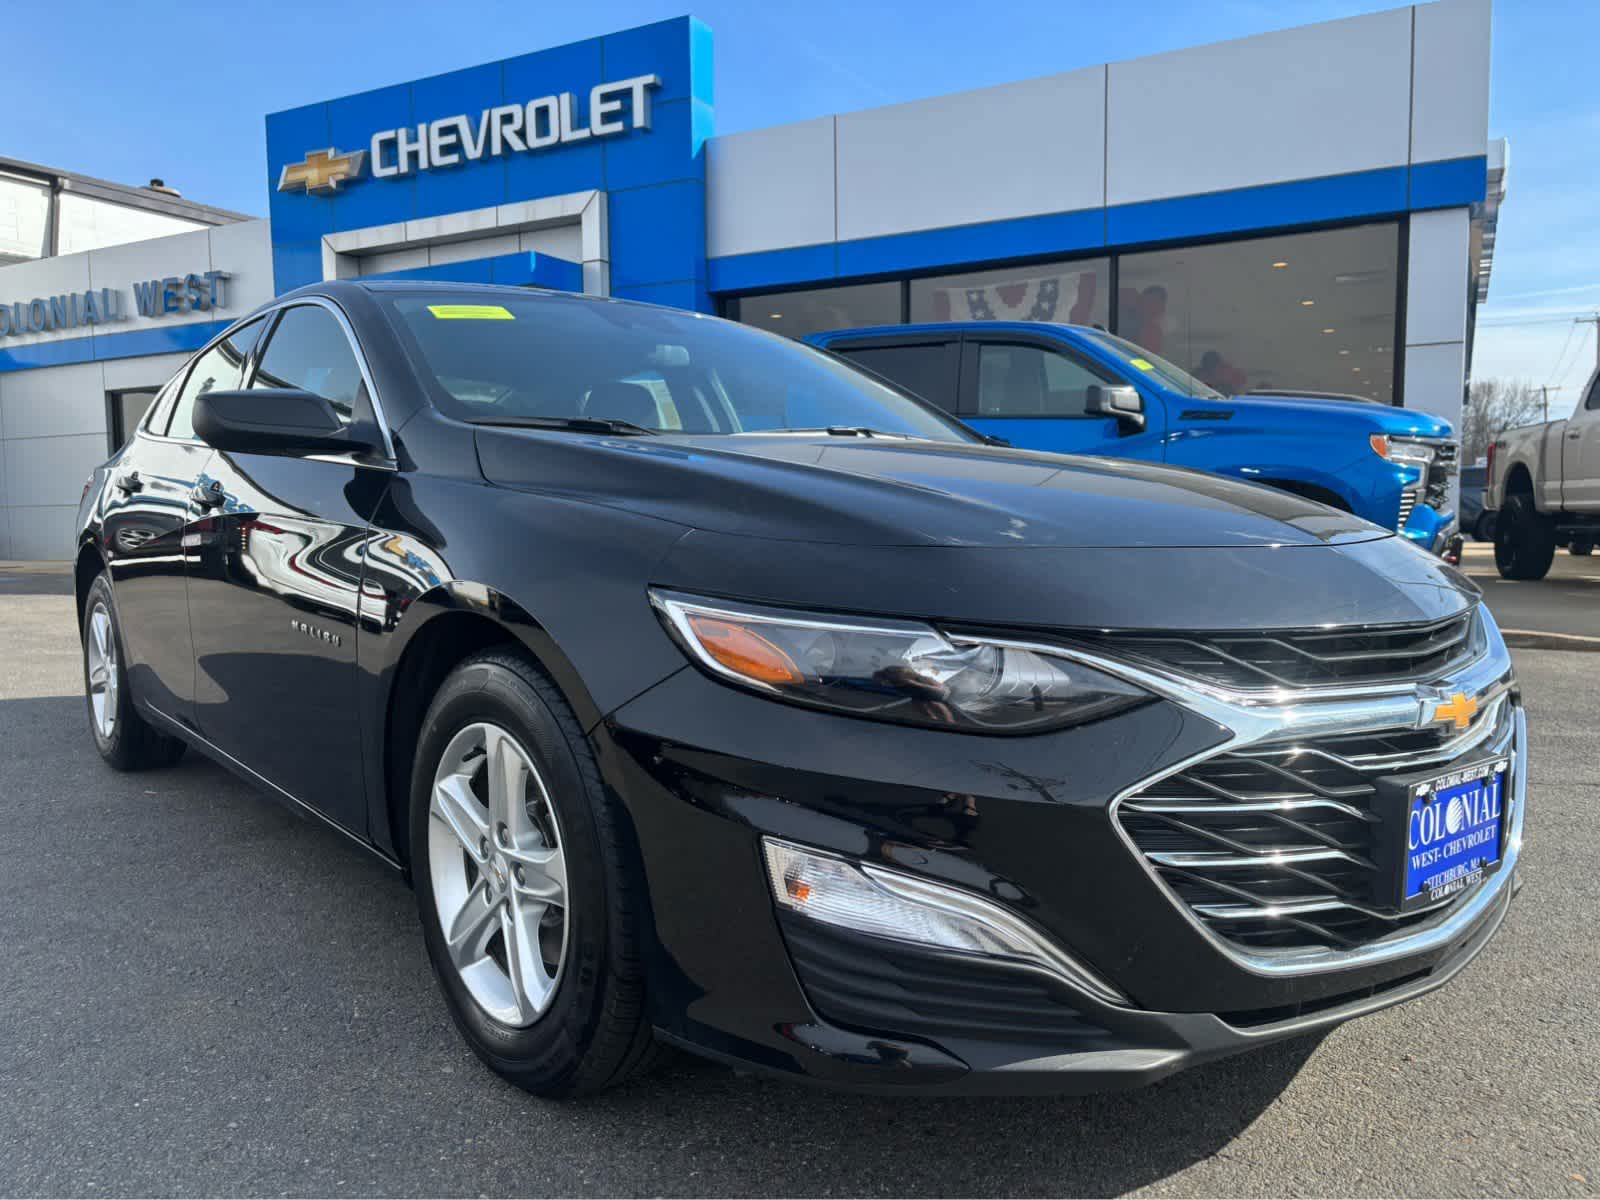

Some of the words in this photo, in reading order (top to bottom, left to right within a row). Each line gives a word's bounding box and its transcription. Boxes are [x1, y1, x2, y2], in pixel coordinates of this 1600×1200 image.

[371, 74, 660, 178] CHEVROLET
[133, 270, 231, 318] WEST
[1408, 783, 1501, 850] COLONIAL
[1443, 824, 1497, 858] CHEVROLET
